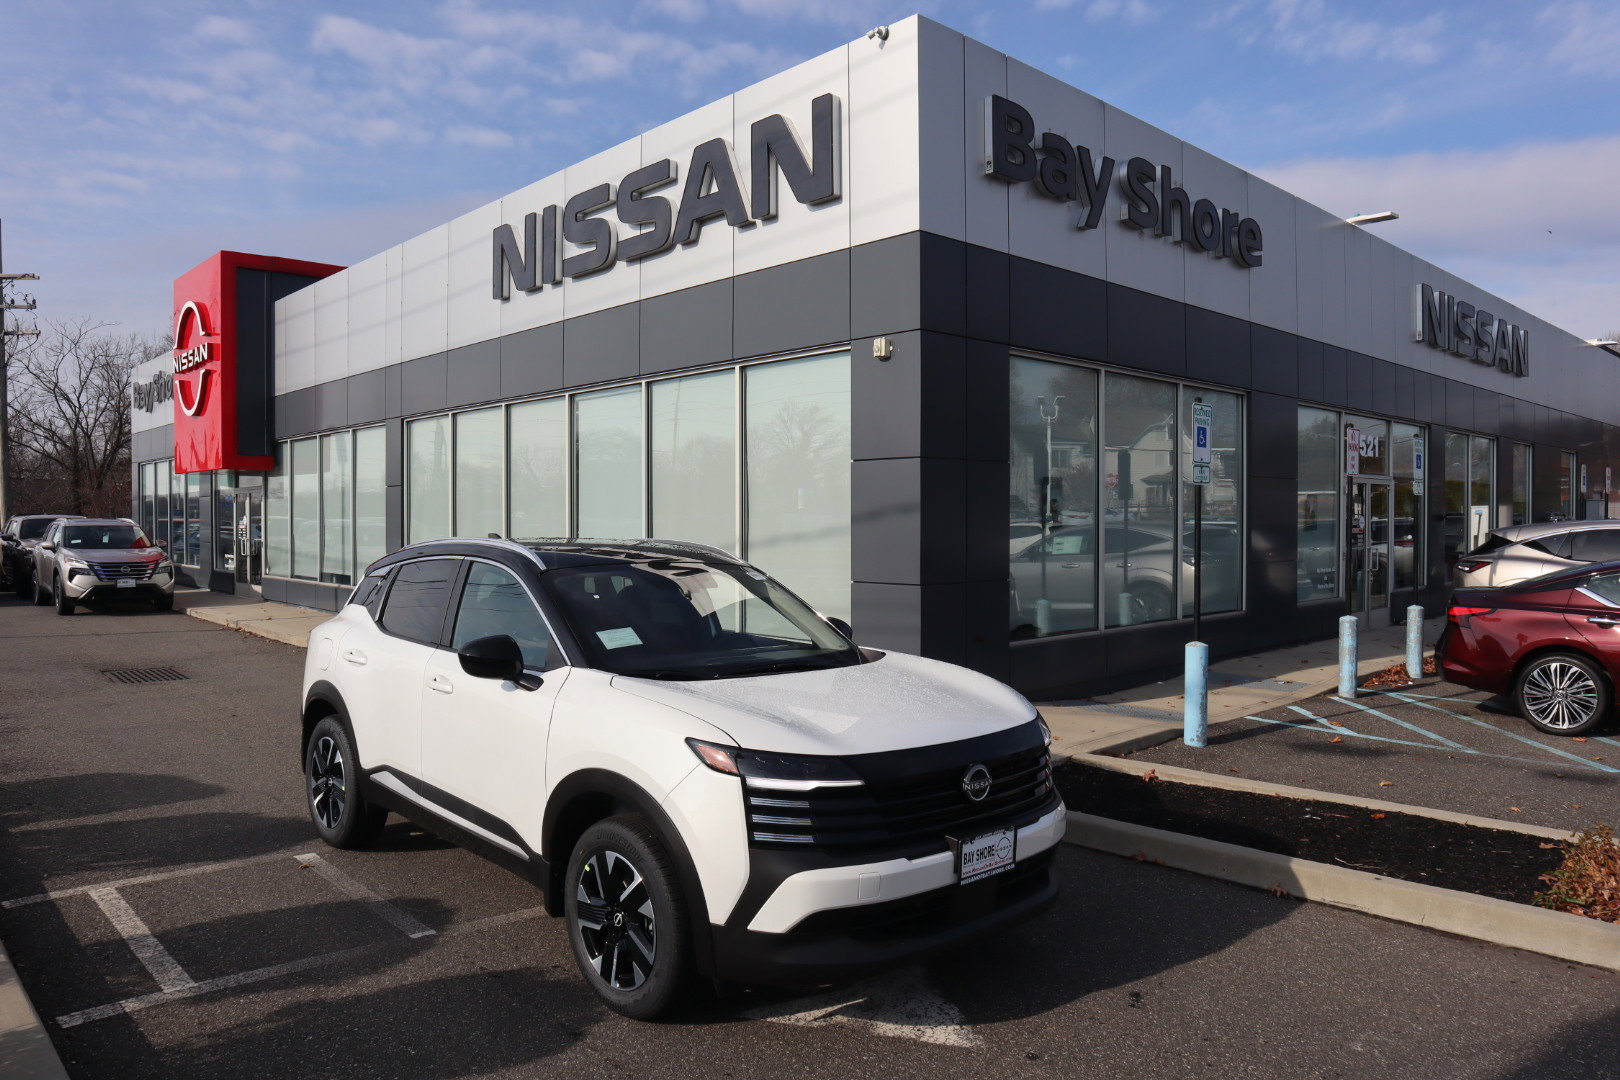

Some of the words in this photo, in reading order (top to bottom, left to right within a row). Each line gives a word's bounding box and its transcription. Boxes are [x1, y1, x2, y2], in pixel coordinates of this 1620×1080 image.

[493, 92, 841, 301] NISSAN
[984, 94, 1115, 230] Bay
[1119, 157, 1262, 268] Shore
[1416, 283, 1529, 377] NISSAN
[173, 342, 208, 373] NISSAN
[133, 382, 154, 413] Bay
[153, 370, 174, 404] Sho
[1360, 435, 1379, 457] 521
[963, 779, 992, 791] NISSAN
[963, 850, 975, 866] BAY
[976, 844, 995, 862] SHORE
